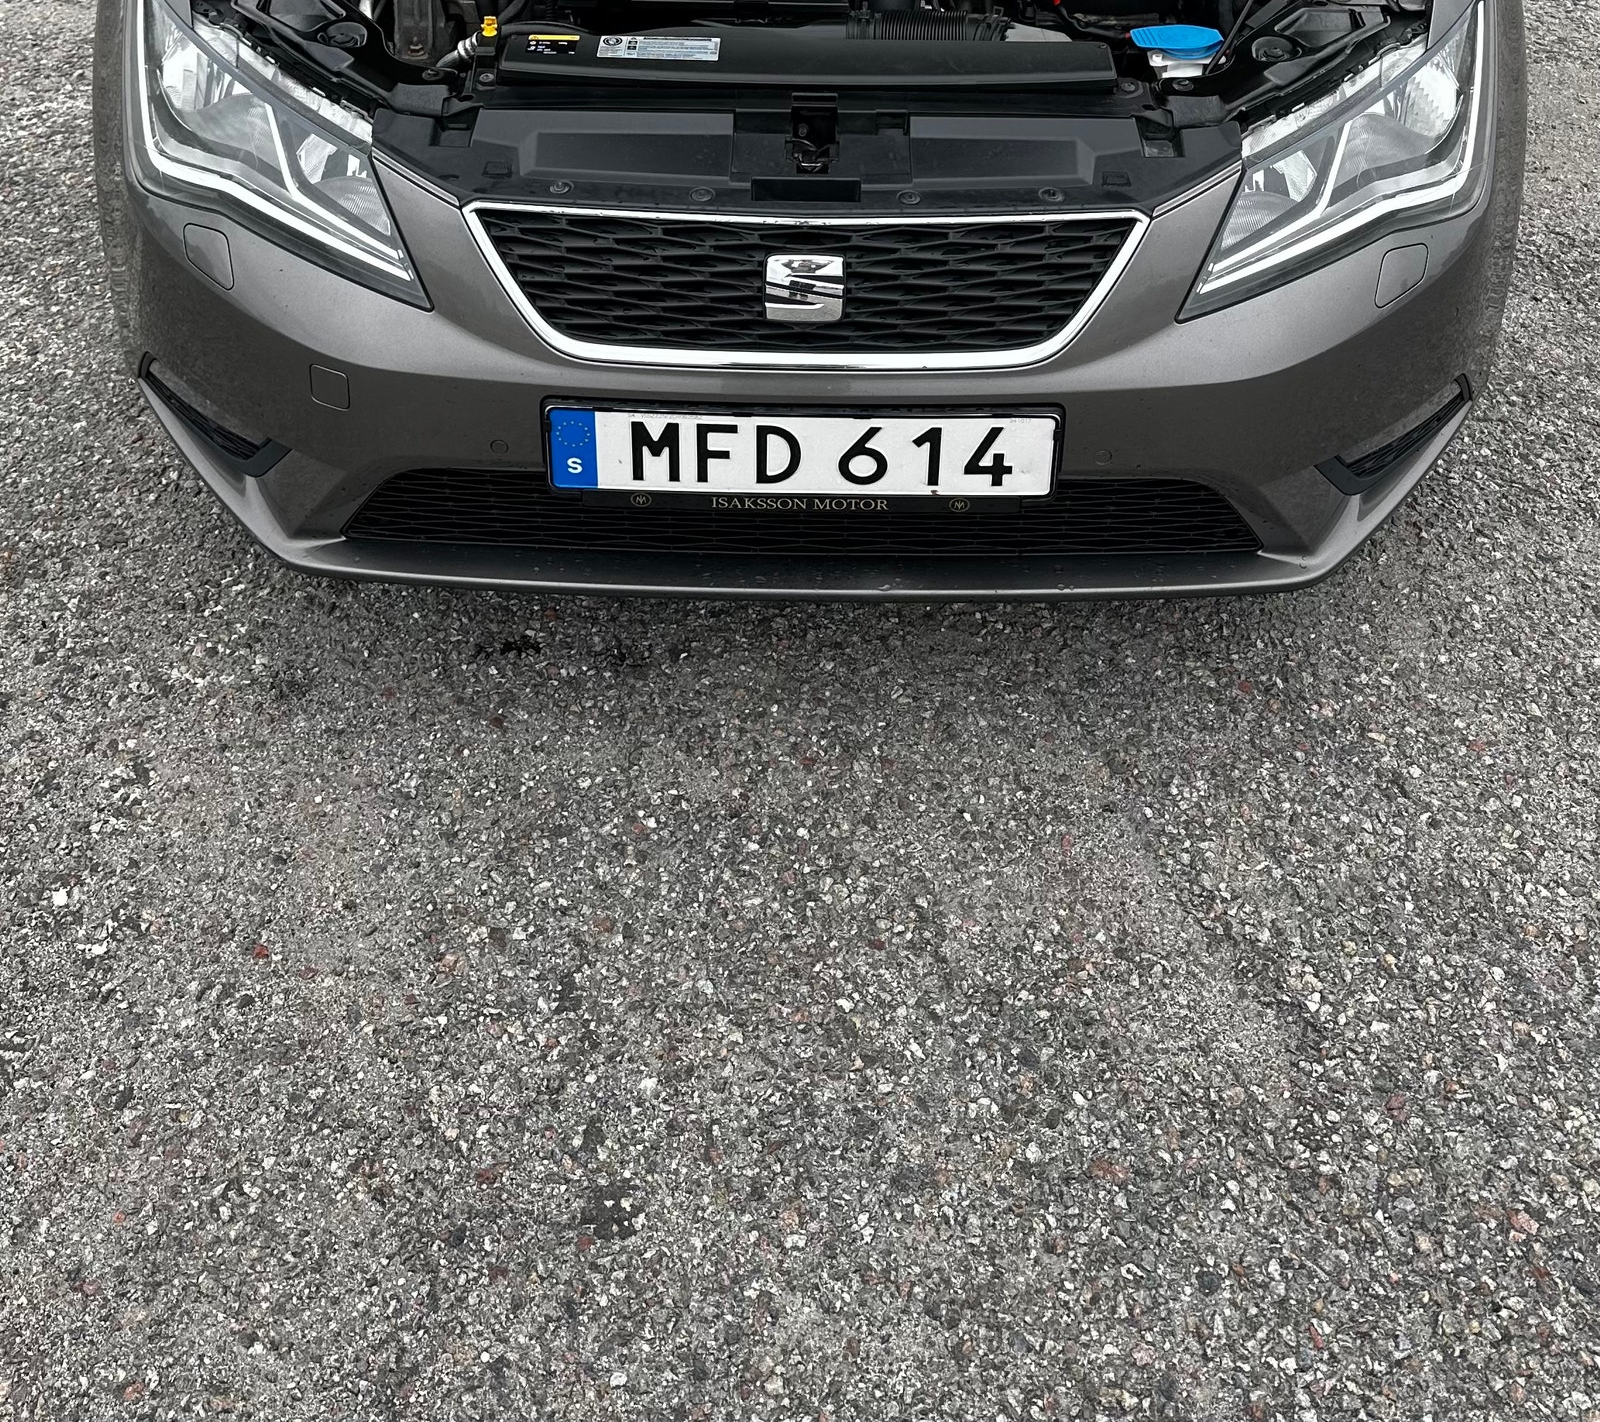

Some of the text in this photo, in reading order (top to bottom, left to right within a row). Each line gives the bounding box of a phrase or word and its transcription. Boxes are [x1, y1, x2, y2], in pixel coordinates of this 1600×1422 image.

[630, 421, 1013, 487] MFD 614
[567, 458, 583, 474] S
[711, 496, 889, 511] ISAKSSON MOTOR
